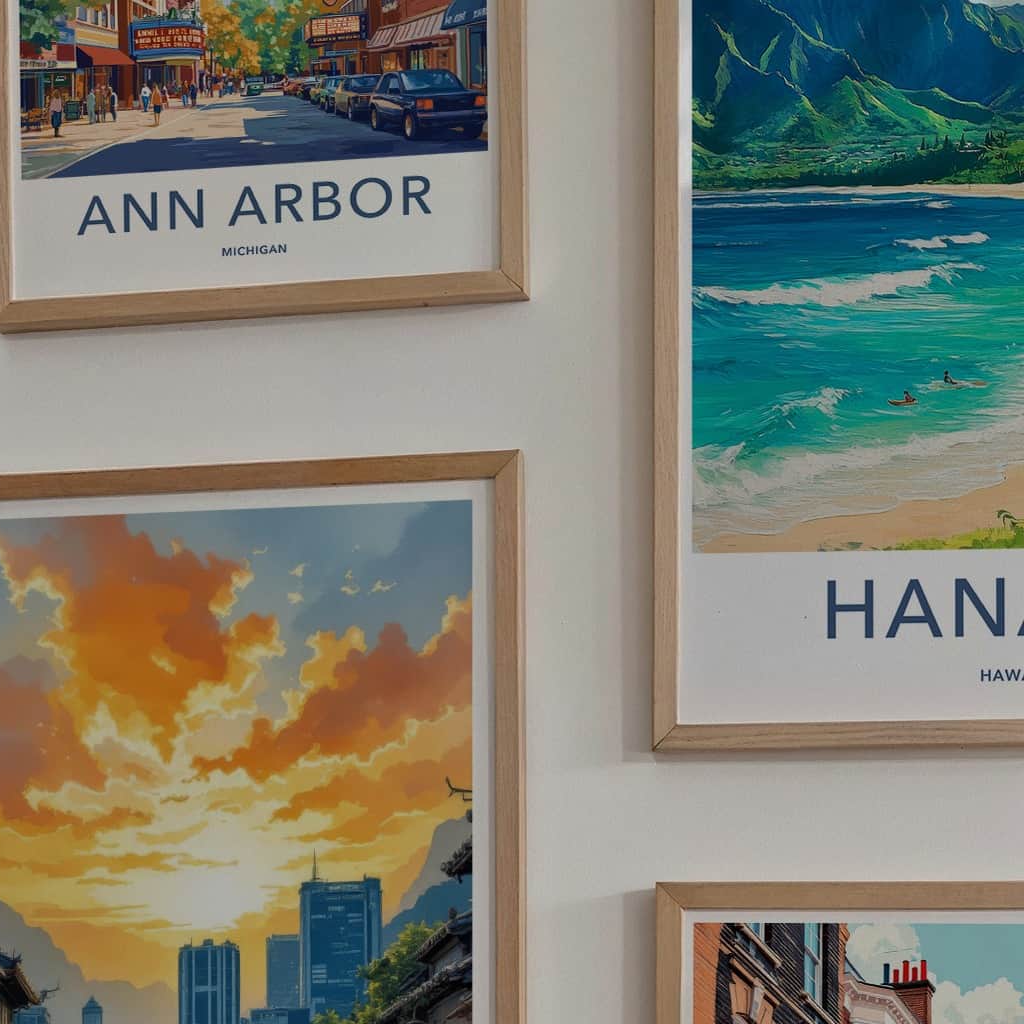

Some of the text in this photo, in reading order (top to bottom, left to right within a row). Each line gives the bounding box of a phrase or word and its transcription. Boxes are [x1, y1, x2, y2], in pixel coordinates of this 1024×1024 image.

[77, 175, 432, 236] ANN ARBOR
[221, 243, 288, 257] MICHIGAN
[826, 577, 1024, 640] HAN
